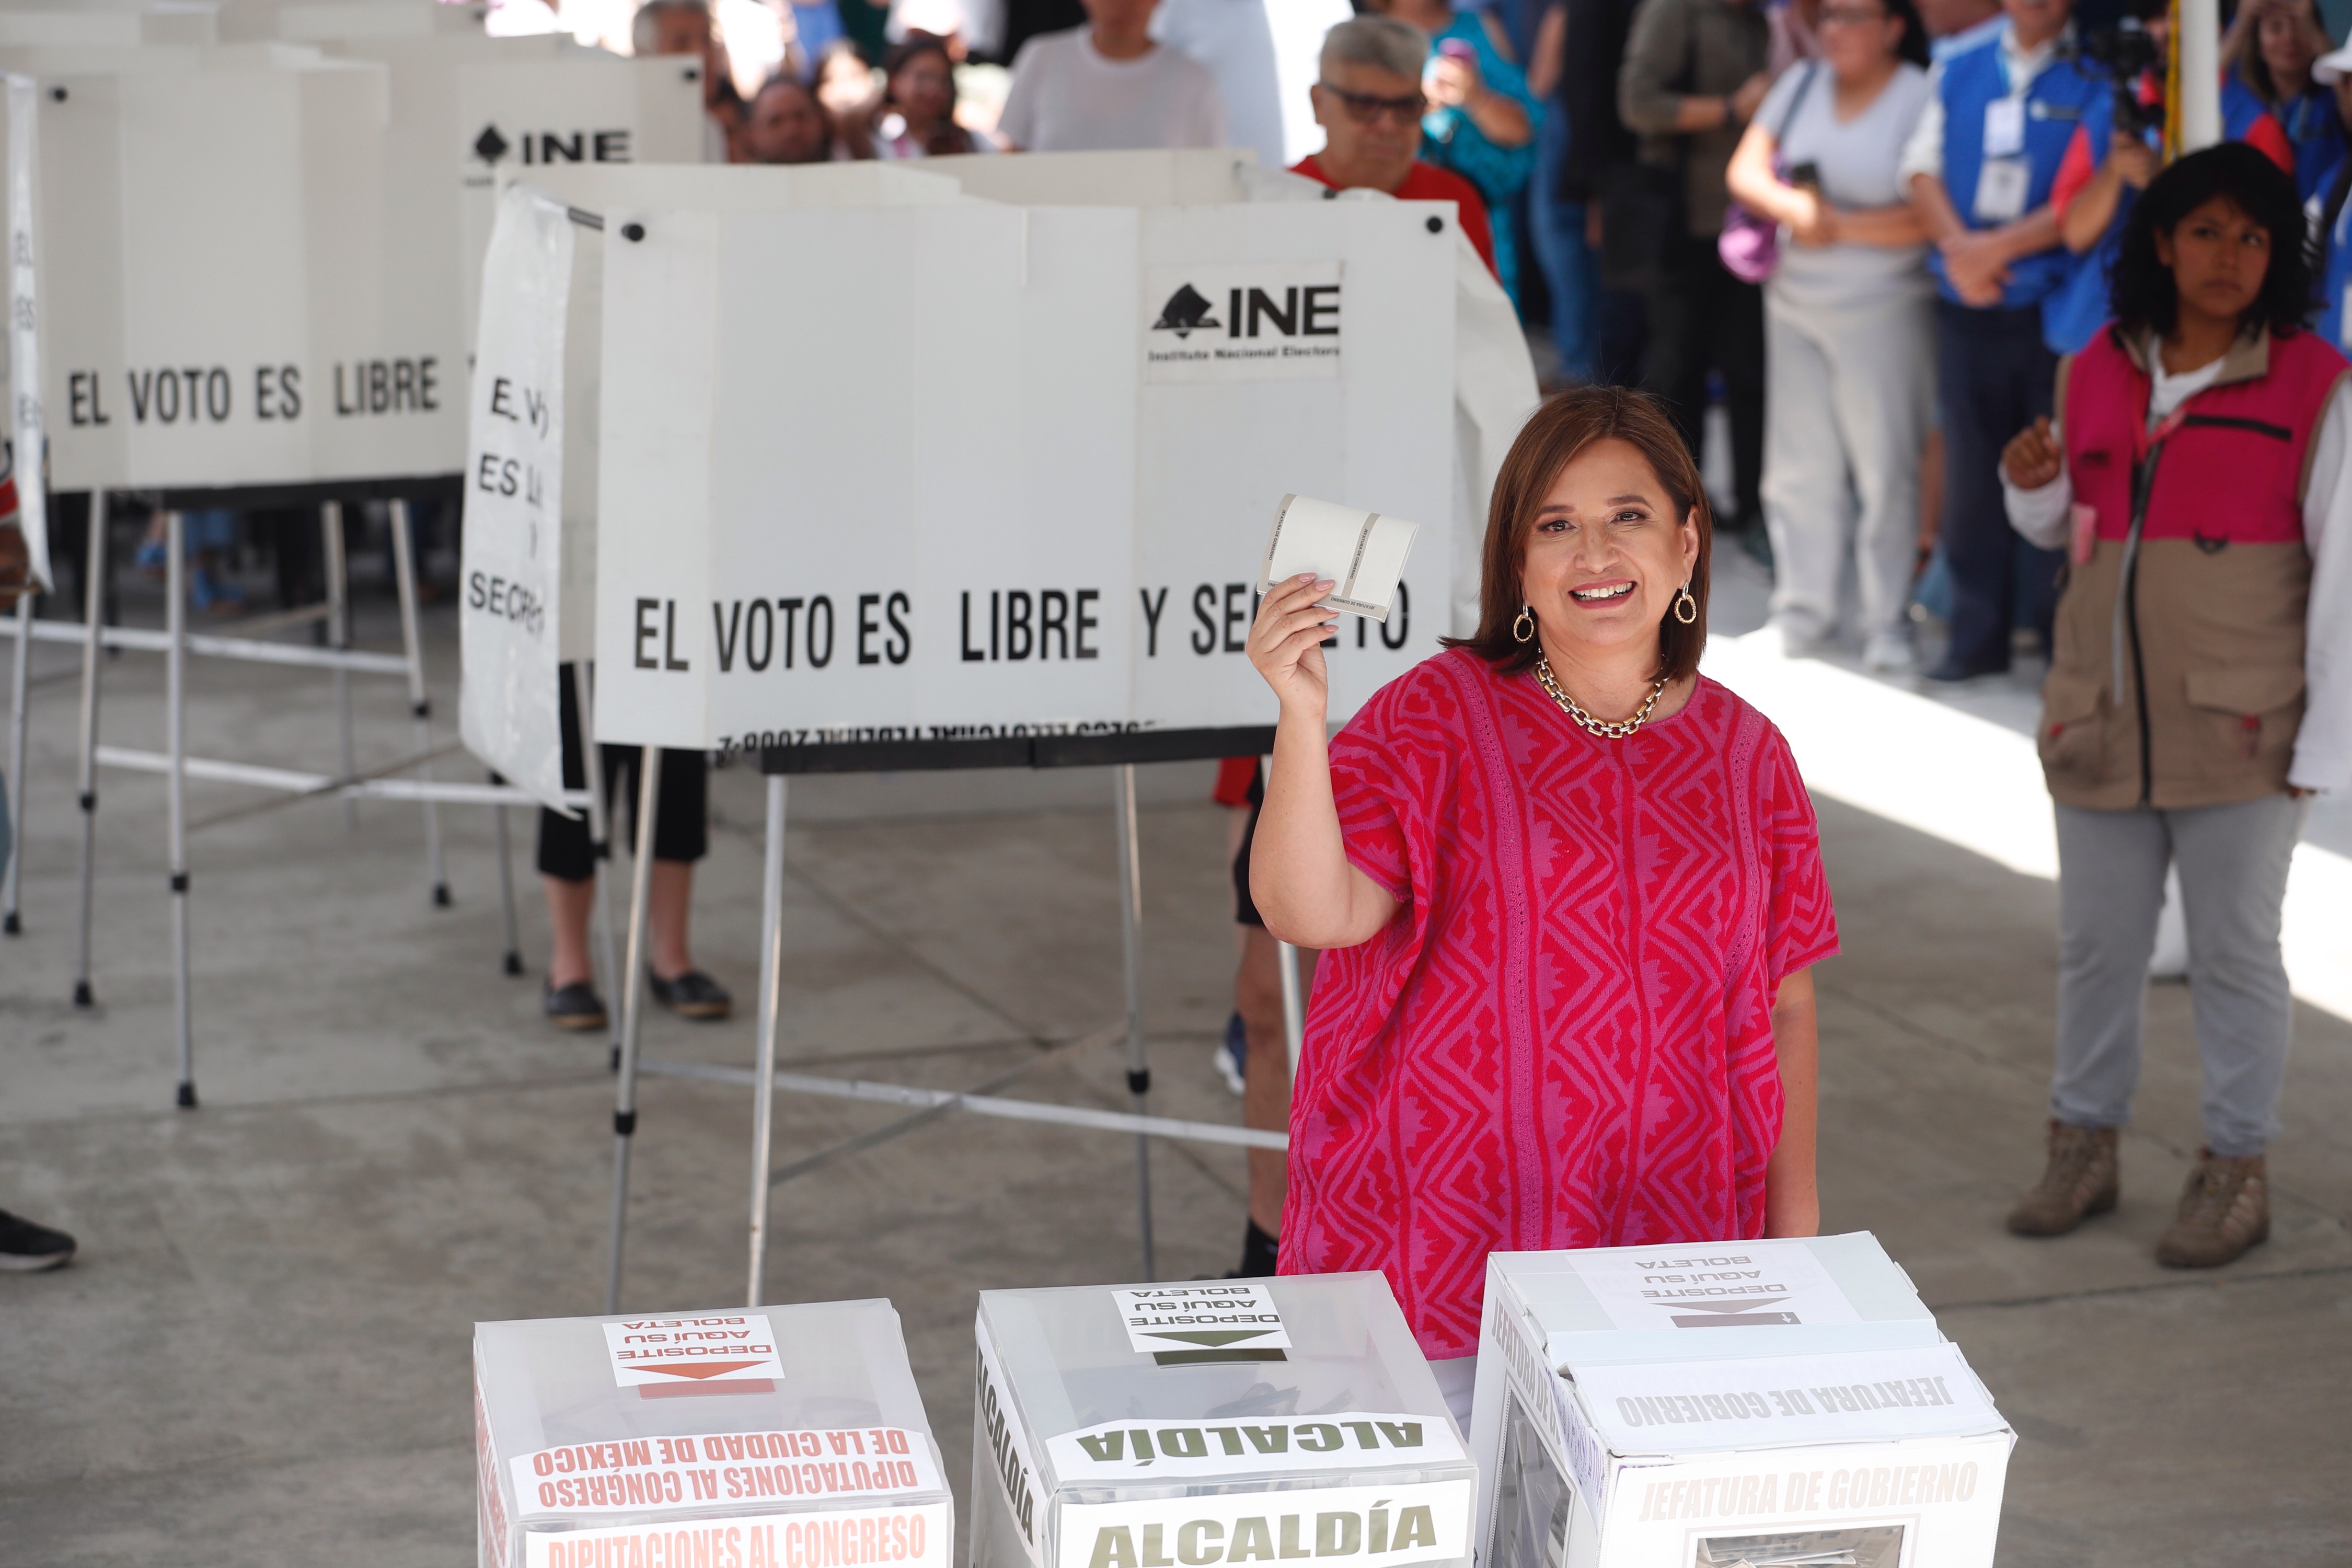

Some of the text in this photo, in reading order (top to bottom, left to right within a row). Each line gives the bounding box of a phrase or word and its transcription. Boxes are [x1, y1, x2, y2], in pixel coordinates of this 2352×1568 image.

[523, 130, 630, 164] INE
[1229, 285, 1340, 338] INE
[70, 370, 110, 427] EL
[128, 366, 232, 423] VOTO
[256, 365, 302, 420] ES
[333, 356, 440, 418] LIBRE
[478, 452, 520, 496] ES
[633, 596, 689, 672] EL
[712, 594, 834, 672] VOTO
[857, 590, 910, 665] ES
[961, 589, 1099, 662] LIBRE
[1140, 586, 1169, 658] Y
[1634, 1255, 1753, 1269] BOLETA
[1644, 1270, 1761, 1285] AQUÍ SU
[1129, 1287, 1251, 1298] BOLETA
[1134, 1300, 1257, 1312] AQUÍ SU
[1640, 1284, 1788, 1298] DEPOSITE
[621, 1317, 746, 1330] BOLETA
[624, 1330, 751, 1344] AQUÍ SU
[1128, 1315, 1281, 1327] DEPOSITE
[616, 1344, 773, 1359] DEPOSITE
[1491, 1295, 1536, 1402] JEFATURA
[1616, 1376, 1955, 1427] JEFATURA DE GOBIERNO
[533, 1429, 910, 1477] DE LA CIUDAD DE MÉXICO
[978, 1344, 1034, 1548] ALCALDÍA
[1076, 1421, 1423, 1467] ALCALDÍA
[538, 1460, 919, 1507] DIPUTACIONES AL CONGRESO
[1639, 1461, 1978, 1523] JEFATURA DE GOBIERNO
[548, 1513, 926, 1568] DIPUTACIONES AL CONGRESO
[1089, 1499, 1437, 1568] ALCALDÍA
